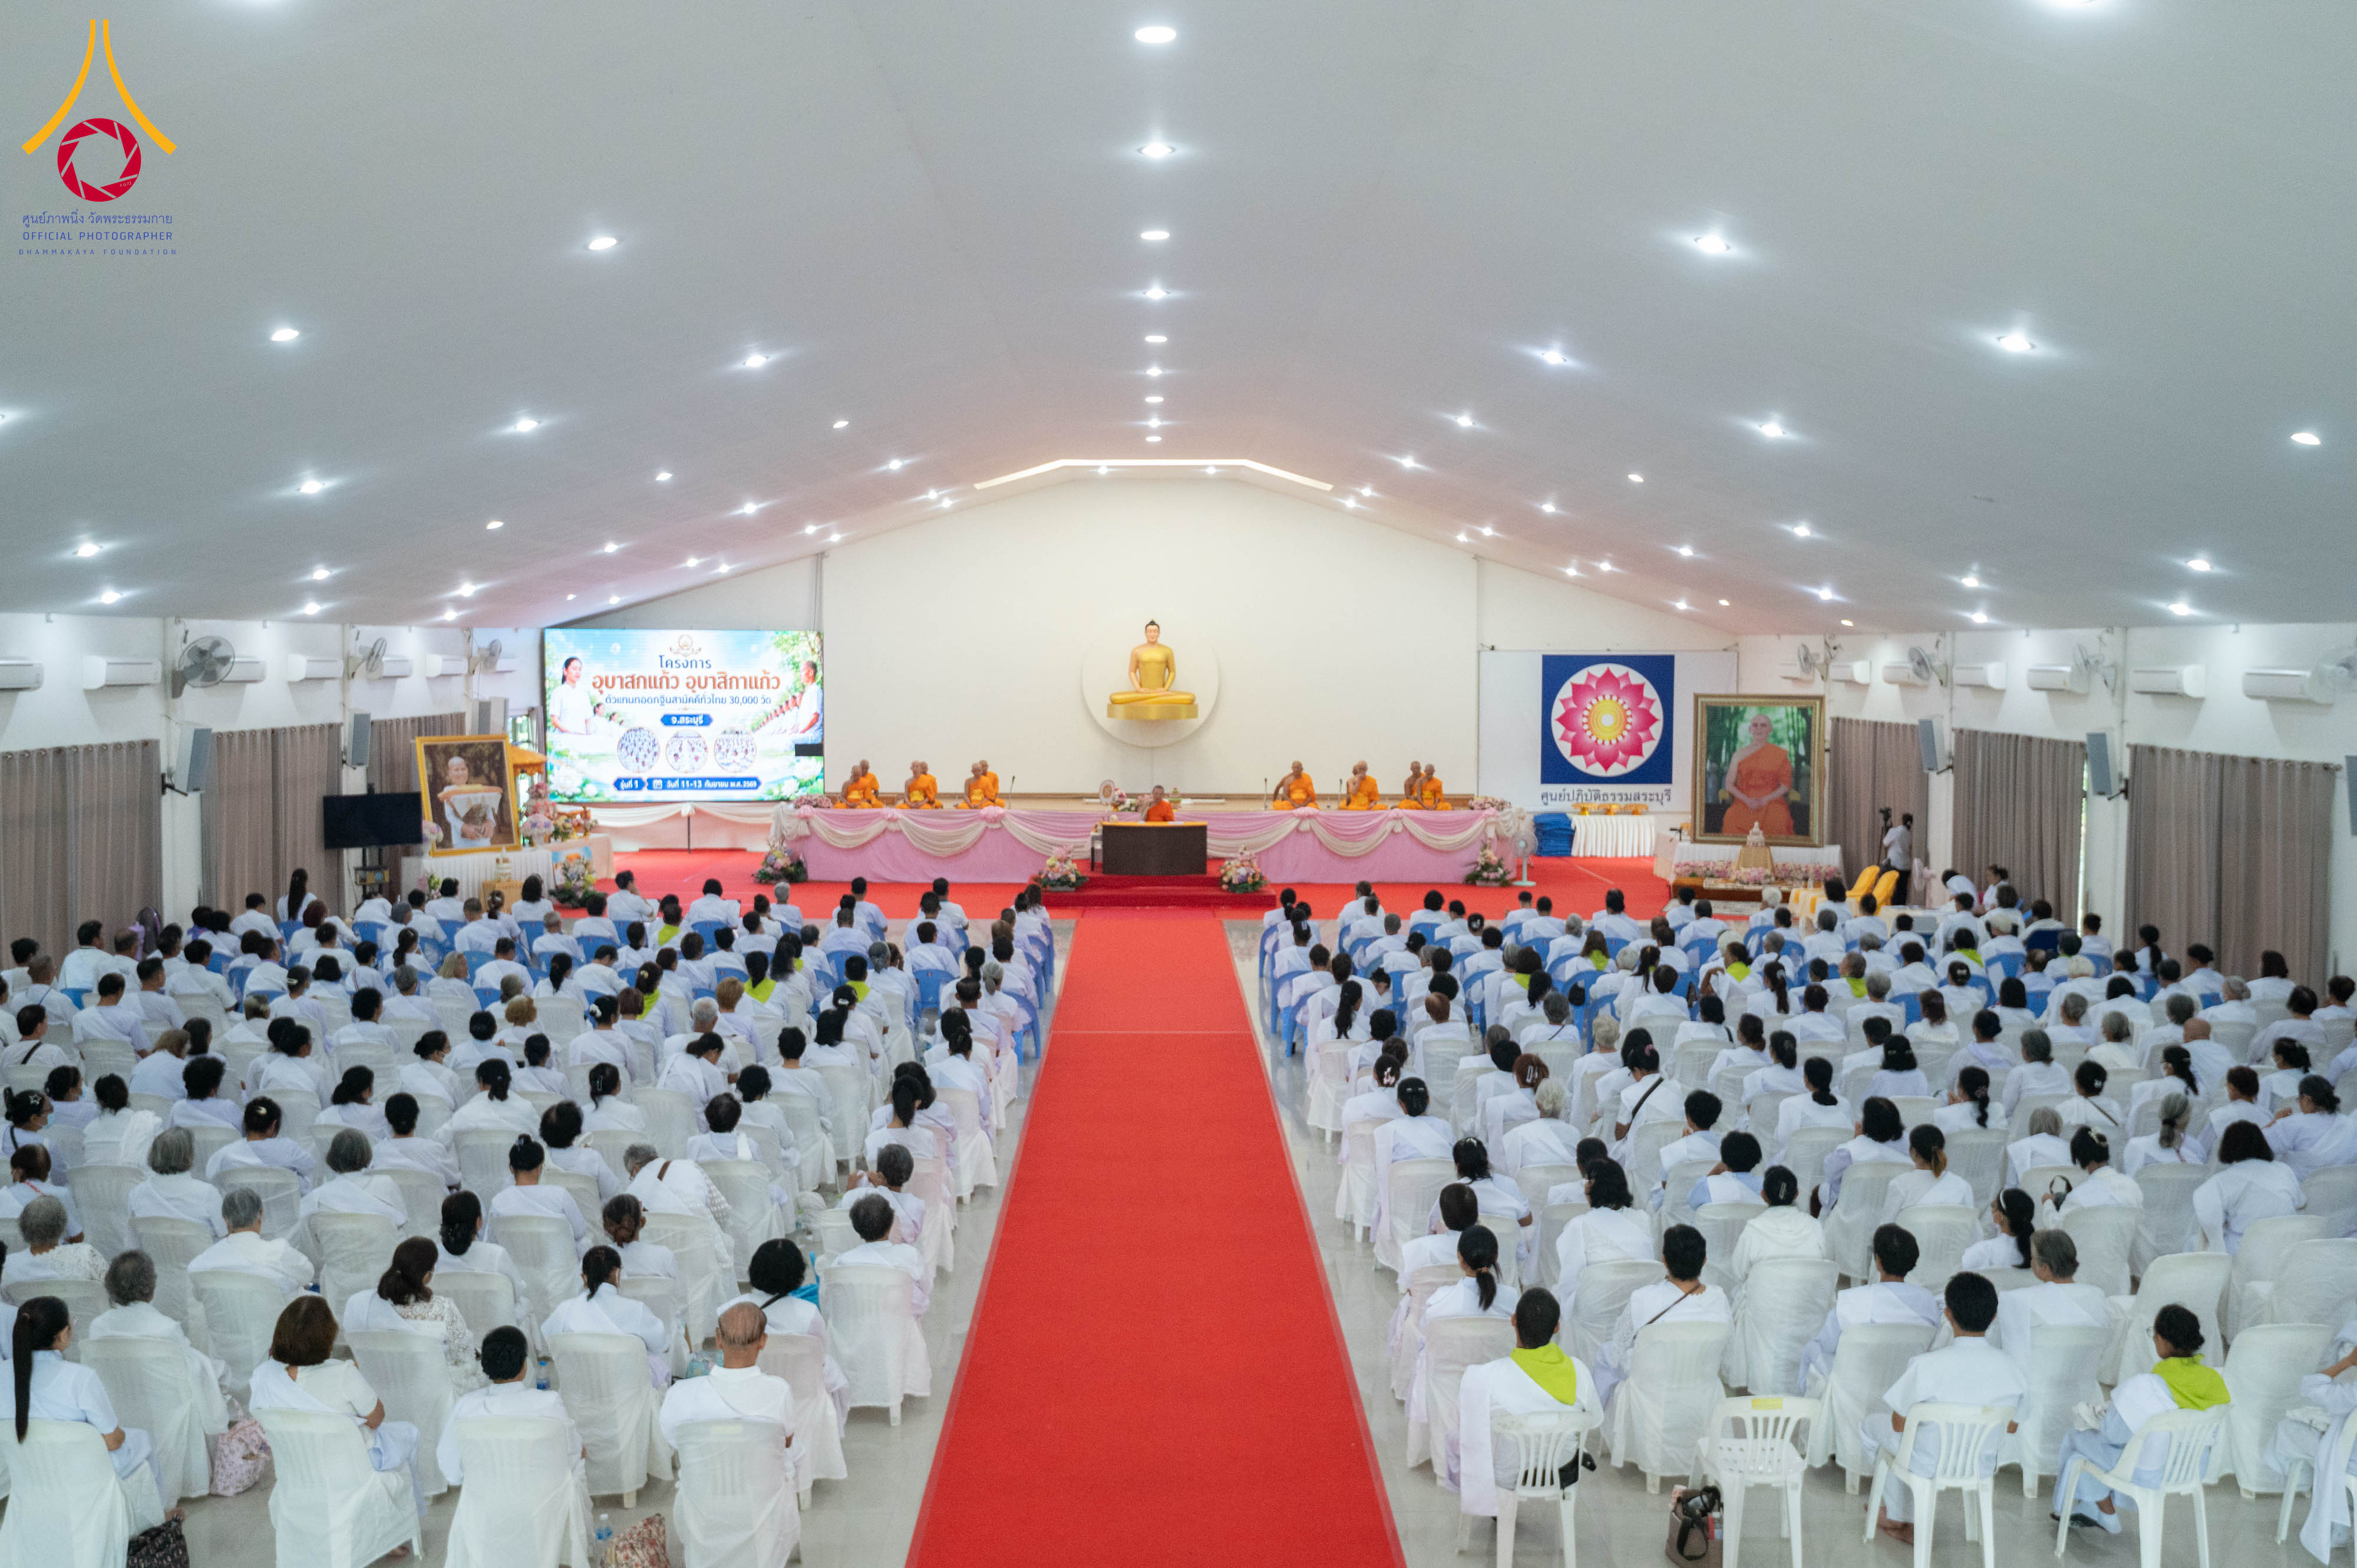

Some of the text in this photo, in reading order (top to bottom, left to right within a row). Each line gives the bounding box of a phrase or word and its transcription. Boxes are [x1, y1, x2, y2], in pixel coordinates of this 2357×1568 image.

[659, 655, 712, 669] โครงการ
[592, 669, 781, 695] อุบาสกแก้ว อุบาสิกาแก้ว
[605, 692, 771, 707] ตัวแทนทอดกฐินสามัคคีทั่วไทย 30,000 วัด
[671, 714, 704, 727] จ.สระบุรี
[634, 780, 638, 788] 1
[681, 780, 702, 788] 11-13
[704, 779, 729, 788] กันยายน
[1541, 787, 1672, 806] ศูนย์ปฏิบัติธรรมสระบุรี
